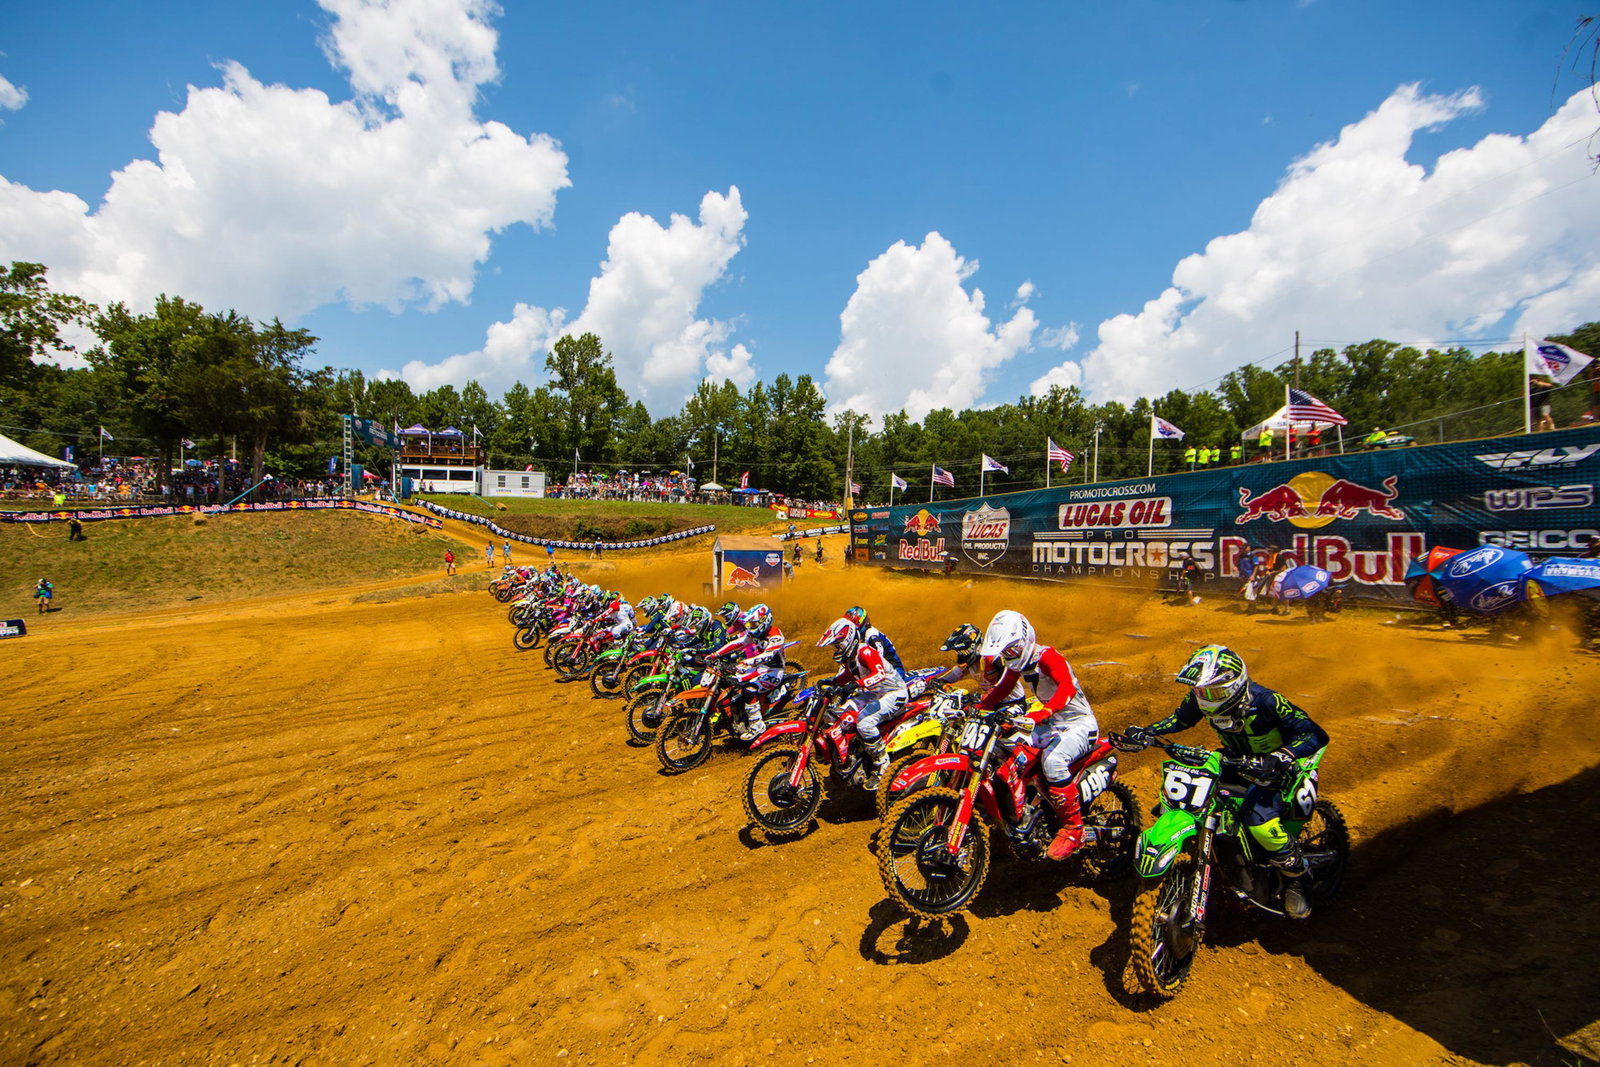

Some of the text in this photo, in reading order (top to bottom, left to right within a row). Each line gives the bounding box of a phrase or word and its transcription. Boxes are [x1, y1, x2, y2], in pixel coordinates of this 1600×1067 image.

[1070, 483, 1156, 500] PROMOTOCROSS.COM
[1063, 500, 1166, 527] LUCAS OIL
[967, 523, 1007, 538] LUCAS
[1087, 530, 1134, 539] PRO
[1479, 530, 1600, 549] GEICO
[899, 538, 921, 560] Red
[921, 538, 945, 562] Bull
[974, 542, 1006, 550] PRODUCTS
[1032, 541, 1214, 569] MOTOCROSS
[1313, 532, 1426, 585] Bull
[1032, 564, 1215, 582] CHAMPIONSHP
[1080, 765, 1110, 803] 496
[1164, 771, 1212, 807] 61
